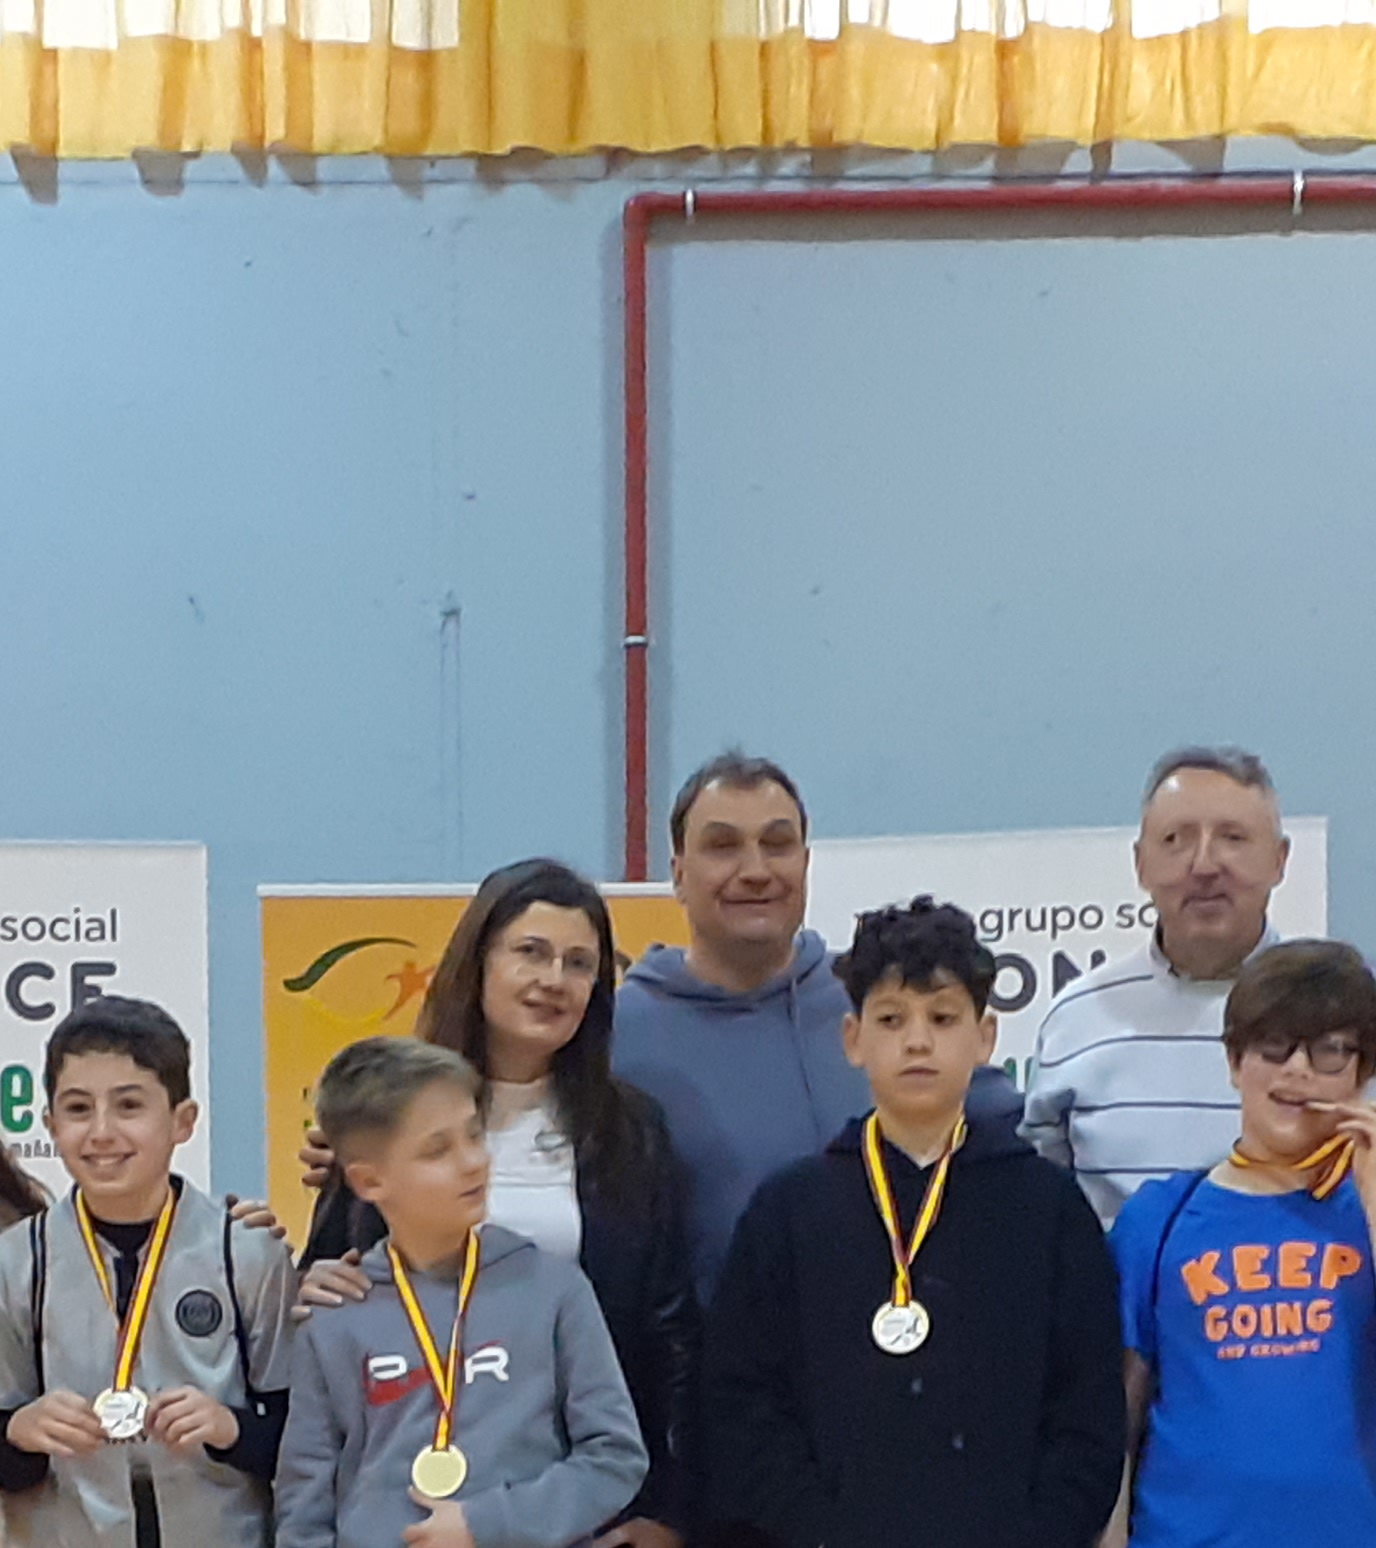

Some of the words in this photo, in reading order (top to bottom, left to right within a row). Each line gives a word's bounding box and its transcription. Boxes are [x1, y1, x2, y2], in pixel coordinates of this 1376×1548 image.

[0, 907, 118, 943] social
[979, 903, 1104, 942] grupo
[1181, 1241, 1362, 1305] KEEP
[1204, 1298, 1334, 1342] GOING
